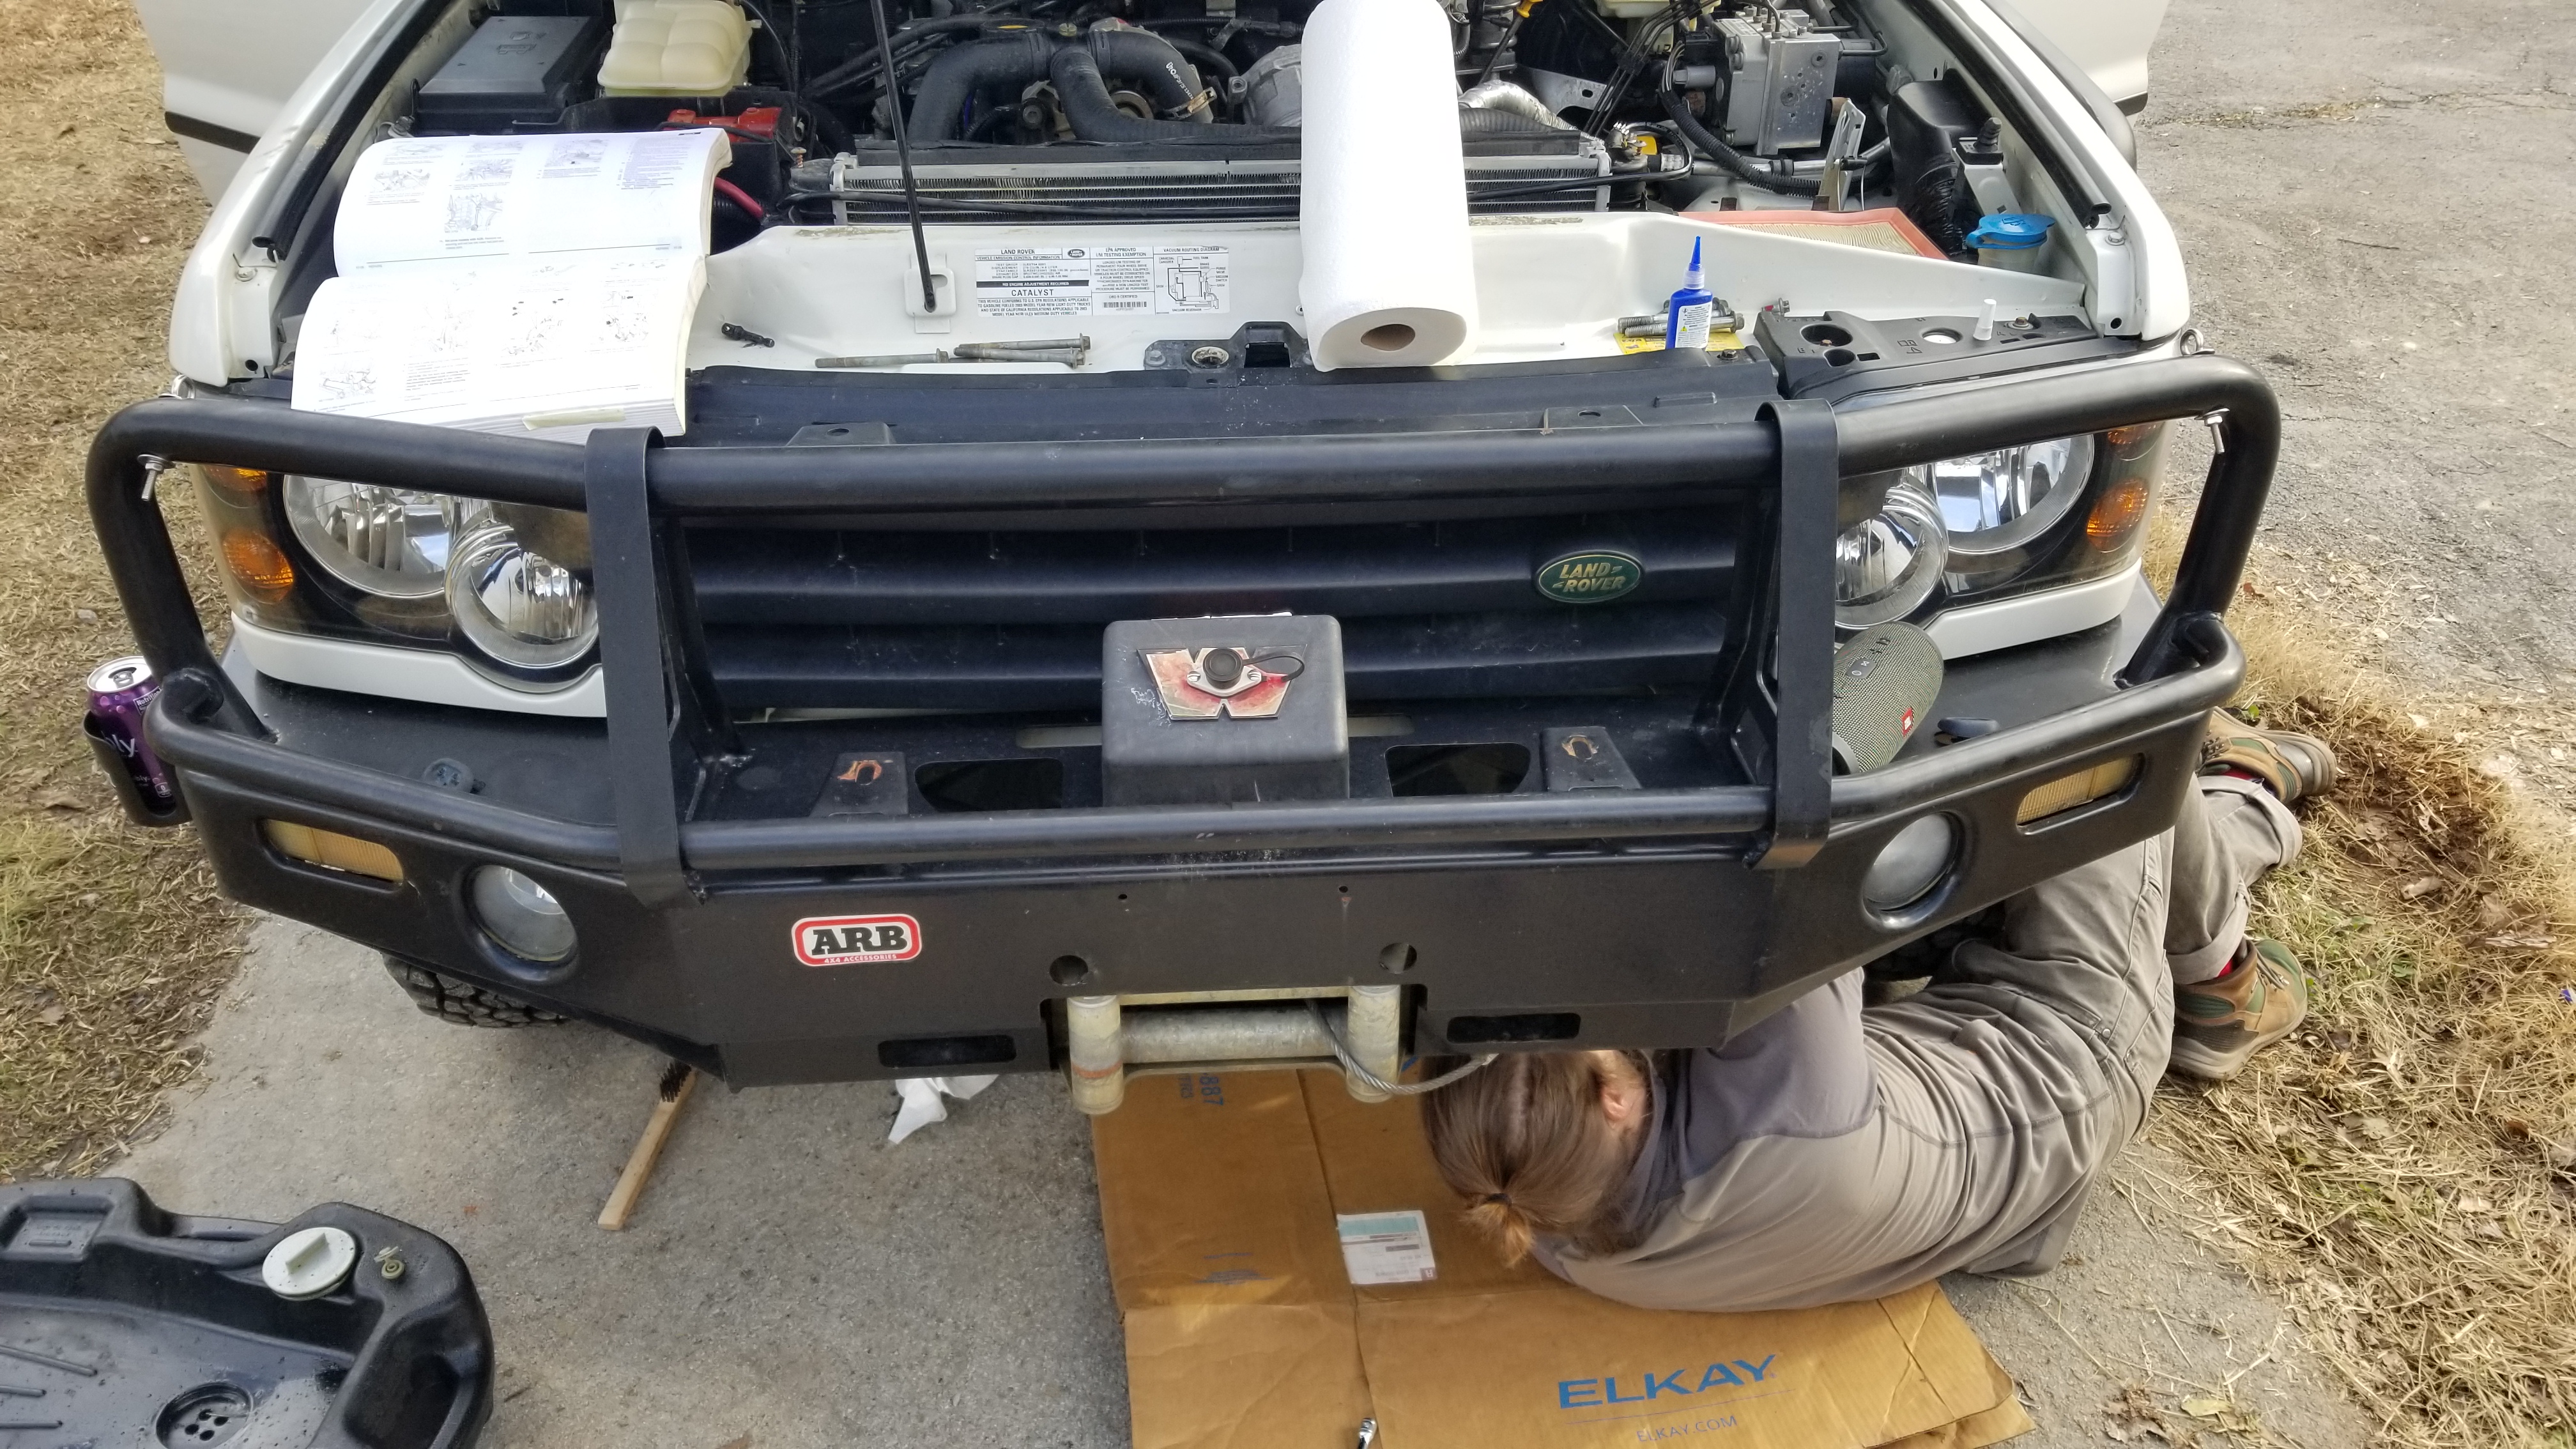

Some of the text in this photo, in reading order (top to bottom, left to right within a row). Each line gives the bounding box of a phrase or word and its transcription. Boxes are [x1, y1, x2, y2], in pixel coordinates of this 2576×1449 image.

[1560, 562, 1611, 578] LAND
[1563, 576, 1626, 592] ROVER
[811, 925, 908, 956] ARB
[843, 954, 897, 962] ACCESSORIES
[1199, 1073, 1223, 1105] 887
[1558, 1354, 1777, 1409] ELKAY
[1636, 1415, 1738, 1442] ELKAY.COM
